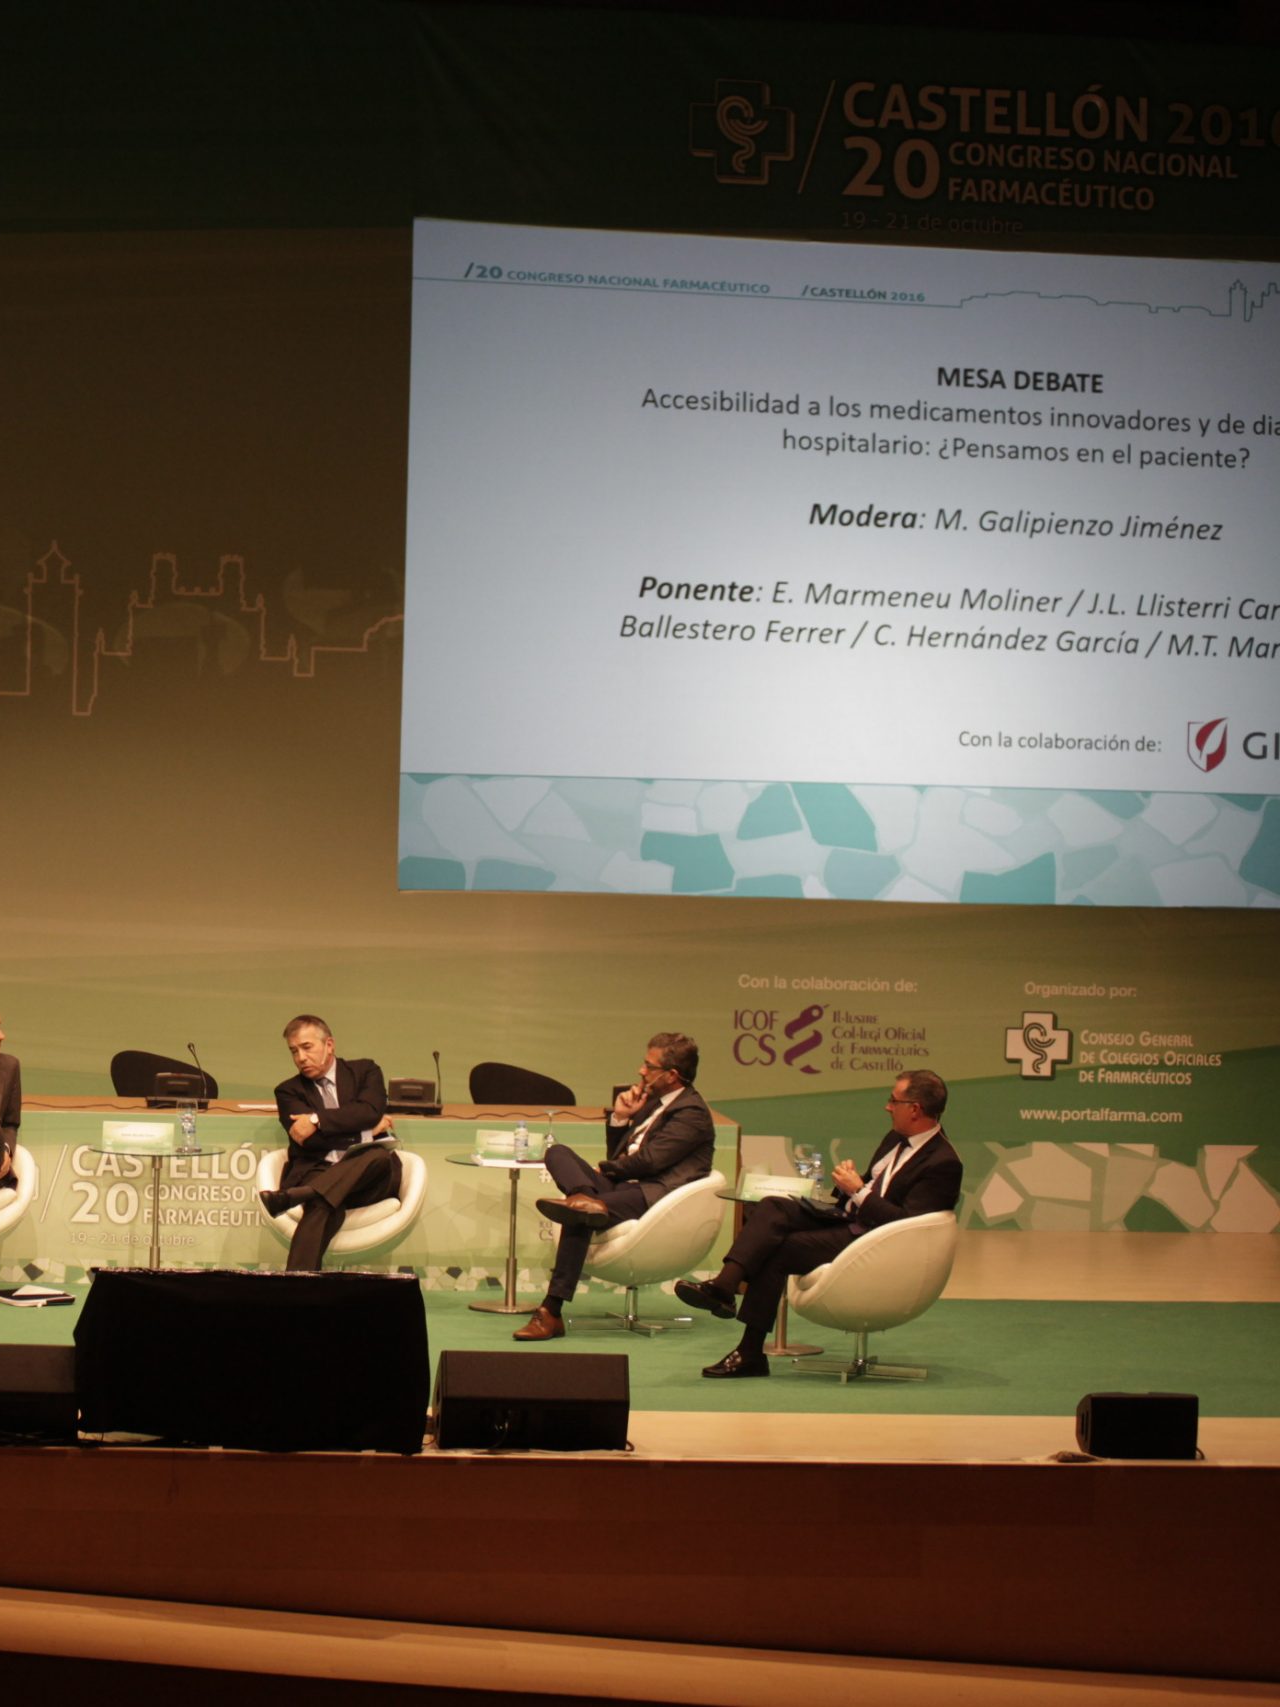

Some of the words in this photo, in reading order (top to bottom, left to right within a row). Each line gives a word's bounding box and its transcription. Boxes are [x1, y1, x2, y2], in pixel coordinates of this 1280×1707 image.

[841, 81, 1150, 142] CASTELLÓN
[1167, 102, 1280, 148] 201
[841, 136, 940, 199] 20
[948, 141, 1095, 172] CONGRESO
[1102, 149, 1239, 180] NACIONAL
[947, 176, 1155, 212] FARMACÉUTICO
[841, 211, 865, 229] 19
[887, 212, 910, 231] 21
[917, 213, 942, 232] de
[948, 215, 1024, 236] octubre
[506, 270, 584, 284] CONGRESO
[588, 274, 659, 288] NACIONAL
[663, 277, 770, 294] FARMACÉUTICO
[890, 290, 926, 302] 2016
[936, 367, 1007, 390] MESA
[1013, 370, 1104, 393] DEBATE
[641, 387, 800, 416] Accesibilidad
[808, 400, 821, 416] a
[829, 395, 862, 418] los
[869, 400, 1042, 427] medicamentos
[1050, 407, 1191, 433] innovadores
[1198, 417, 1211, 438] y
[1217, 412, 1245, 434] de
[782, 428, 930, 456] hospitalario:
[938, 437, 1070, 463] ¿Pensamos
[1076, 447, 1105, 464] en
[1112, 443, 1132, 465] el
[1140, 446, 1251, 470] paciente?
[809, 503, 925, 529] Modera:
[935, 508, 968, 531] M.
[978, 510, 1114, 539] Galipienzo
[1119, 515, 1224, 541] Jiménez
[638, 576, 763, 602] Ponente:
[772, 581, 793, 604] E.
[804, 582, 951, 609] Marmeneu
[960, 587, 1062, 613] Moliner
[1087, 592, 1126, 616] J.L.
[1136, 593, 1231, 619] Llisterri
[1238, 598, 1280, 621] Car
[619, 614, 756, 641] Ballestero
[765, 620, 846, 645] Ferrer
[873, 624, 895, 647] C.
[906, 625, 1049, 651] Hernández
[1056, 629, 1140, 655] García
[1167, 633, 1218, 658] M.T.
[1227, 635, 1280, 660] Mar
[958, 729, 993, 747] Con
[997, 731, 1013, 749] la
[1017, 733, 1130, 752] colaboración
[1134, 734, 1162, 753] de:
[738, 974, 769, 989] Con
[774, 975, 787, 989] la
[791, 976, 890, 992] colaboración
[894, 978, 918, 993] de:
[1024, 981, 1106, 998] Organizado
[1109, 985, 1137, 999] por:
[733, 1009, 779, 1031] ICOF
[733, 1033, 777, 1066] CS
[1079, 1052, 1095, 1065] DE
[1079, 1071, 1094, 1083] DE
[1019, 1107, 1183, 1123] www.portalfarma.com
[70, 1181, 140, 1225] 20
[143, 1184, 245, 1202] CONGRESO
[70, 1232, 87, 1244] 19
[98, 1232, 117, 1244] 21
[122, 1232, 138, 1245] de
[143, 1233, 195, 1246] otubre
